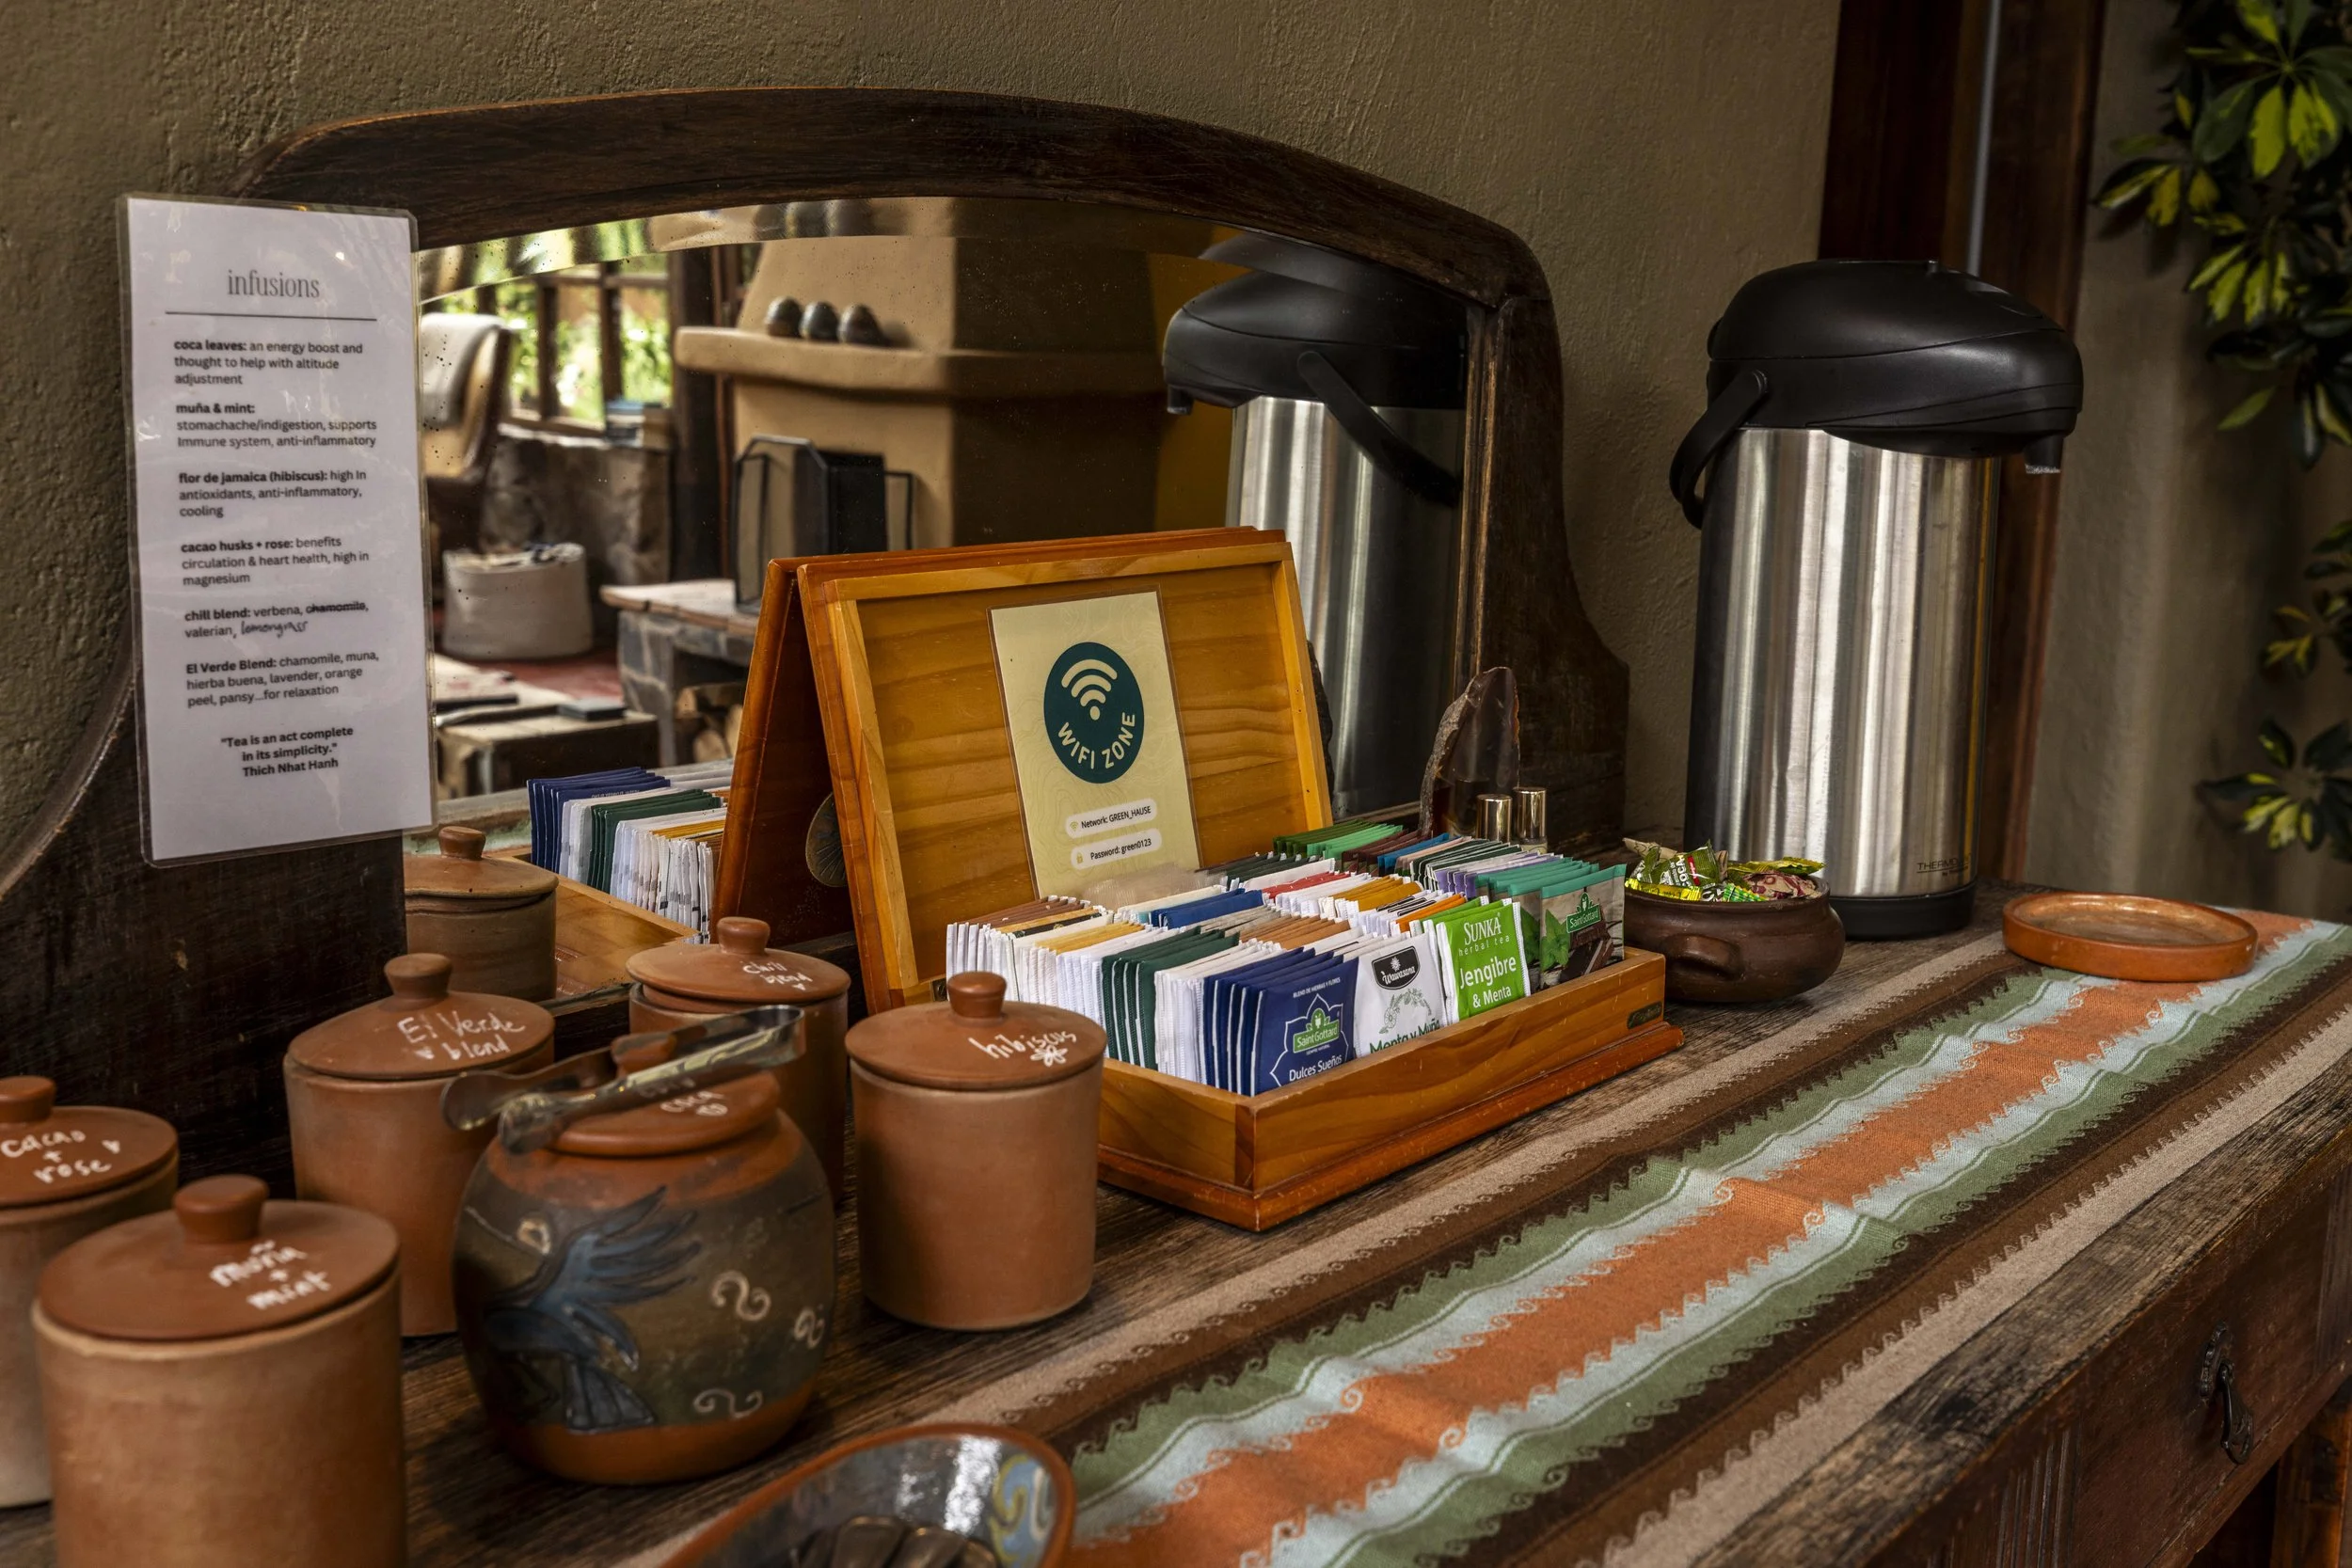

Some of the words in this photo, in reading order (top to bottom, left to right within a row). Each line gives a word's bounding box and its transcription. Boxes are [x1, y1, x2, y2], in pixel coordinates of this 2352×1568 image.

[227, 269, 321, 298] infusions
[174, 340, 203, 352] coca
[205, 340, 247, 352] leaves:
[249, 342, 263, 352] an
[266, 343, 306, 356] energy
[309, 341, 340, 354] boost
[342, 342, 363, 354] and
[174, 356, 222, 371] thought
[225, 357, 237, 368] to
[240, 357, 266, 370] help
[268, 358, 294, 369] with
[295, 358, 340, 370] altitude
[175, 373, 243, 387] adjustment
[175, 403, 211, 414] muña
[213, 403, 222, 414] &
[224, 404, 256, 415] mint:
[176, 419, 326, 433] stomachache/indigestion,
[329, 420, 377, 433] supports
[229, 436, 274, 451] system,
[276, 435, 377, 449] anti-inflammatory
[179, 472, 201, 483] flor
[203, 472, 219, 483] de
[221, 472, 267, 485] jamaica
[269, 470, 328, 483] (hibiscus):
[329, 469, 353, 483] high
[179, 488, 256, 501] antioxidants,
[258, 485, 363, 499] anti-inflammatory,
[179, 505, 224, 519] cooling
[181, 542, 216, 553] cacao
[219, 539, 254, 551] husks
[264, 540, 294, 550] rose:
[295, 536, 342, 548] benefits
[182, 556, 246, 570] circulation
[247, 556, 257, 567] &
[259, 554, 290, 566] heart
[292, 552, 330, 565] health,
[333, 550, 357, 564] high
[358, 550, 370, 562] in
[183, 572, 251, 588] magnesium
[184, 610, 211, 622] chill
[213, 607, 251, 621] blend:
[253, 605, 304, 618] verbena,
[184, 626, 237, 640] valerian,
[186, 662, 198, 674] El
[199, 660, 237, 673] Verde
[239, 657, 278, 671] Blend:
[279, 653, 344, 668] chamomile,
[186, 677, 226, 690] hierba
[228, 674, 267, 688] buena,
[269, 670, 323, 685] lavender,
[325, 667, 363, 681] orange
[187, 694, 217, 709] peel,
[283, 685, 340, 699] relaxation
[220, 736, 248, 749] "Tea
[250, 735, 261, 746] is
[262, 734, 278, 745] an
[278, 732, 298, 743] act
[299, 727, 354, 741] complete
[1057, 721, 1095, 769] WIFI
[1102, 712, 1136, 769] ZONE
[242, 752, 254, 763] in
[256, 750, 271, 760] its
[273, 742, 339, 759] simplicity."
[242, 765, 276, 778] Thich
[278, 762, 307, 774] Nhat
[308, 757, 340, 771] Hanh
[1081, 816, 1108, 829] Network:
[1108, 805, 1152, 823] GREEN_HAUSE
[1090, 845, 1120, 861] Password:
[1120, 838, 1152, 854] green0123
[1463, 916, 1502, 946] SUNKA
[1458, 940, 1490, 958] herbal
[1494, 935, 1511, 947] tea
[1459, 956, 1518, 990] Jengibre
[1472, 992, 1482, 1008] &
[1483, 985, 1513, 1005] Menta
[436, 1010, 526, 1037] Verde
[441, 1034, 512, 1060] blend
[967, 1031, 1077, 1059] hibiscus
[1289, 1065, 1317, 1082] Dulces
[1317, 1054, 1343, 1073] Sueños
[33, 1159, 112, 1183] rose
